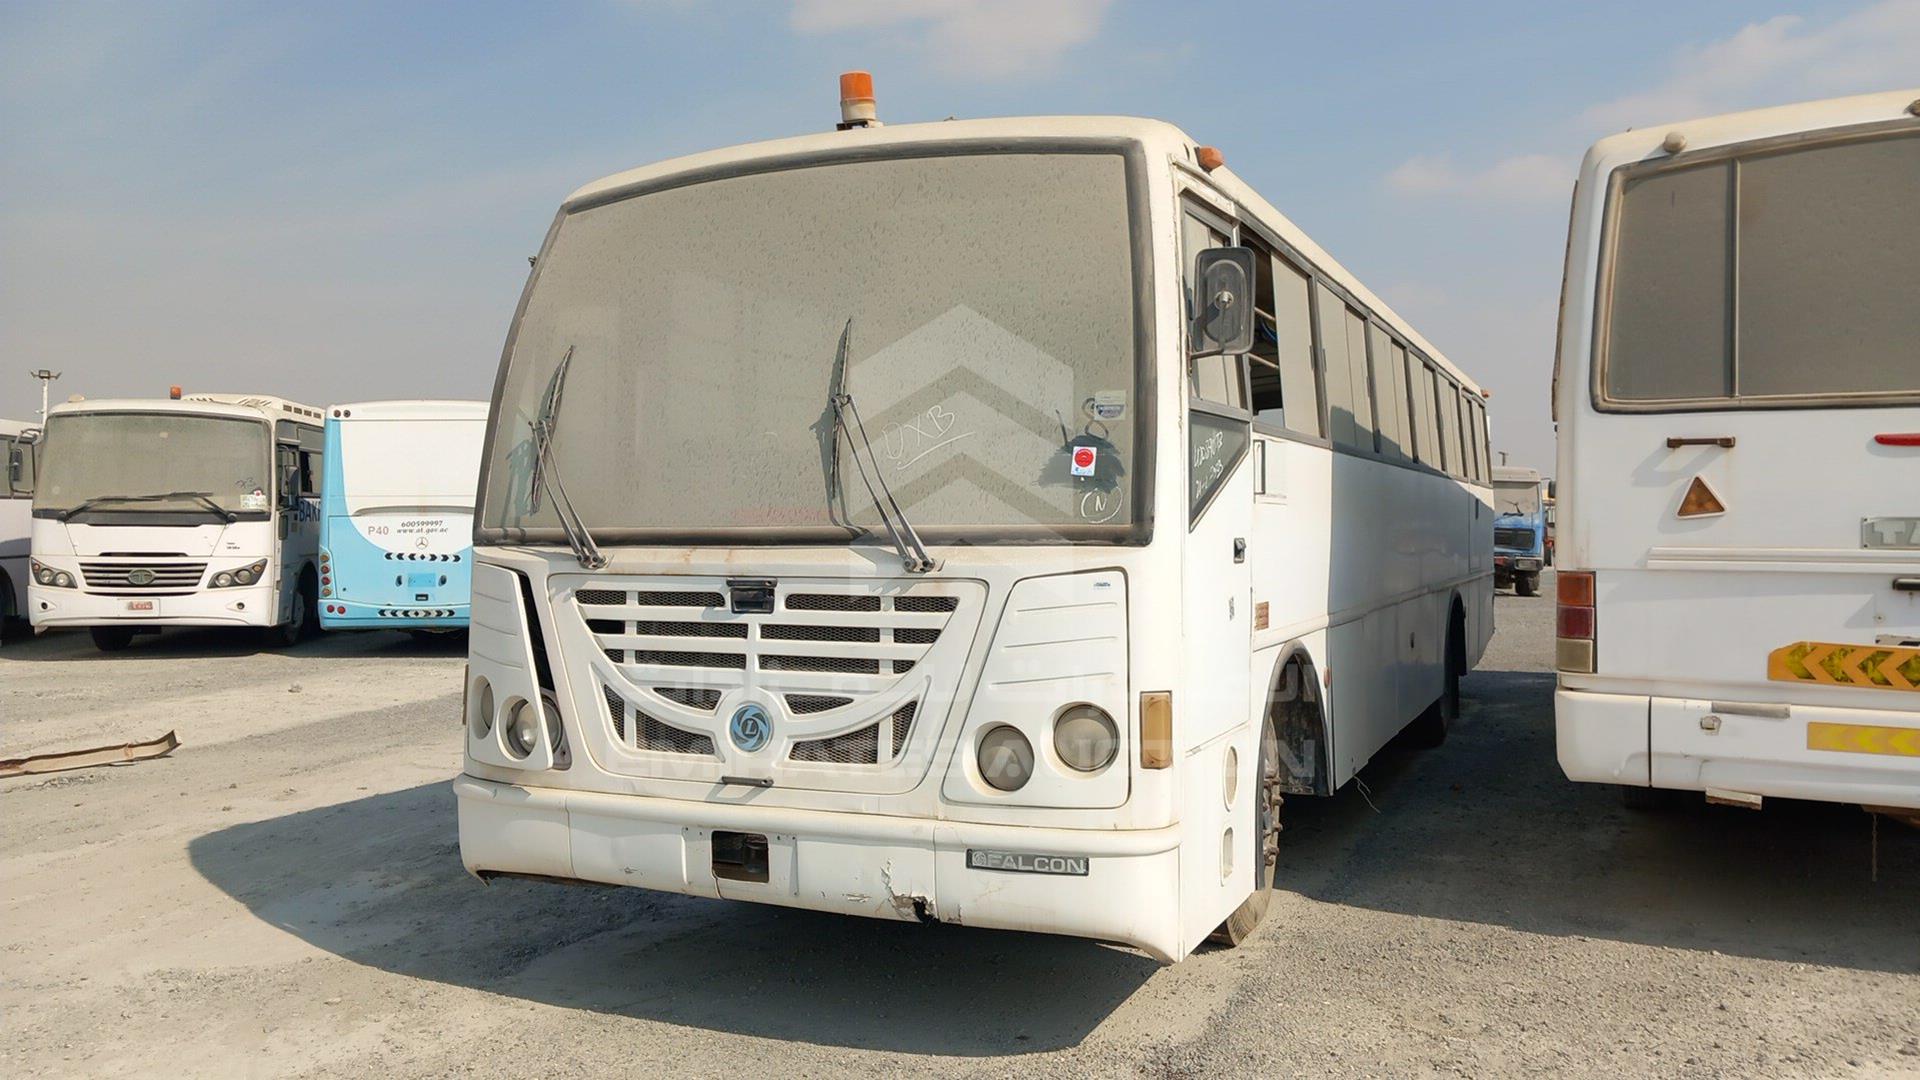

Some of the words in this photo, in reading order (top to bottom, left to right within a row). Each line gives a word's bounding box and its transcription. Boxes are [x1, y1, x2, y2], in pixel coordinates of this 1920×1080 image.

[299, 499, 321, 521] BAK
[367, 526, 390, 536] P40
[986, 850, 1087, 875] FALCON
